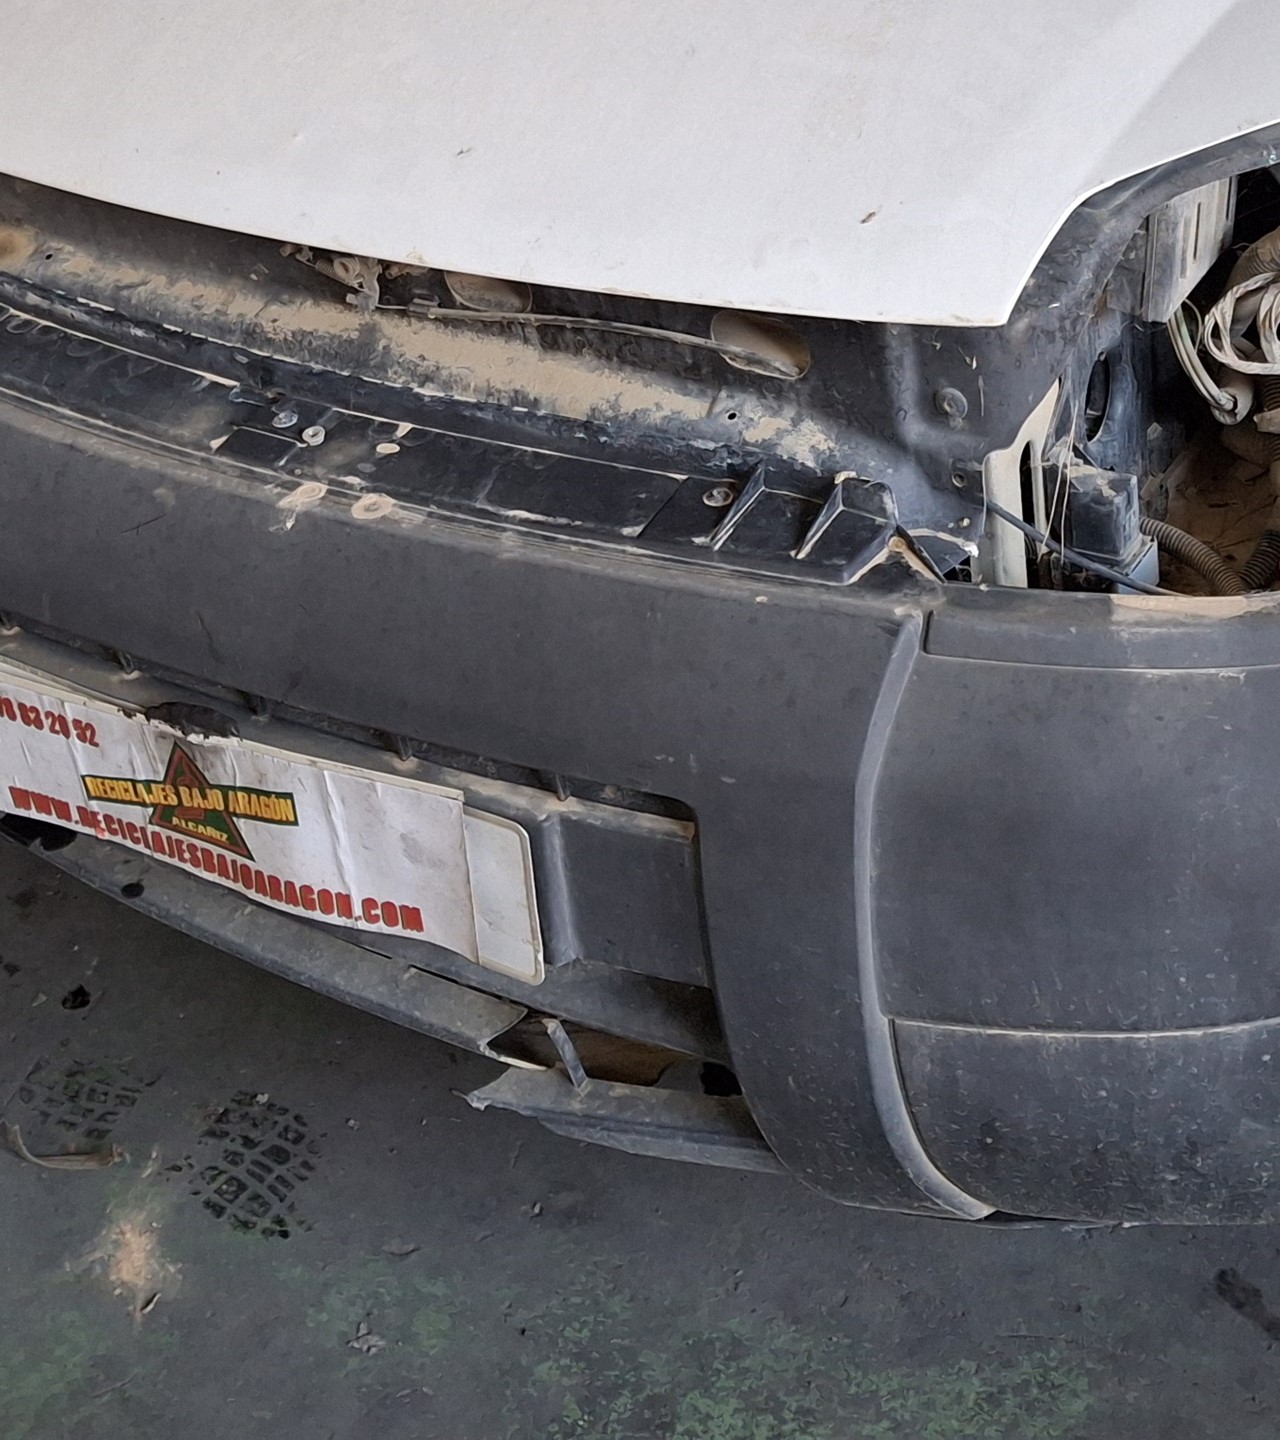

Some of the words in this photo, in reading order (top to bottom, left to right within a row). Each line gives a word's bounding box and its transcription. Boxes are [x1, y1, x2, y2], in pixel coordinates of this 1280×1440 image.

[45, 710, 71, 740] 20
[72, 718, 100, 748] 52
[84, 776, 179, 807] RECICLAJES
[178, 785, 225, 811] BAJO
[228, 789, 296, 822] ARAGÓN
[8, 785, 425, 933] WWW.RECICLAJESBAJOARAGON.COM
